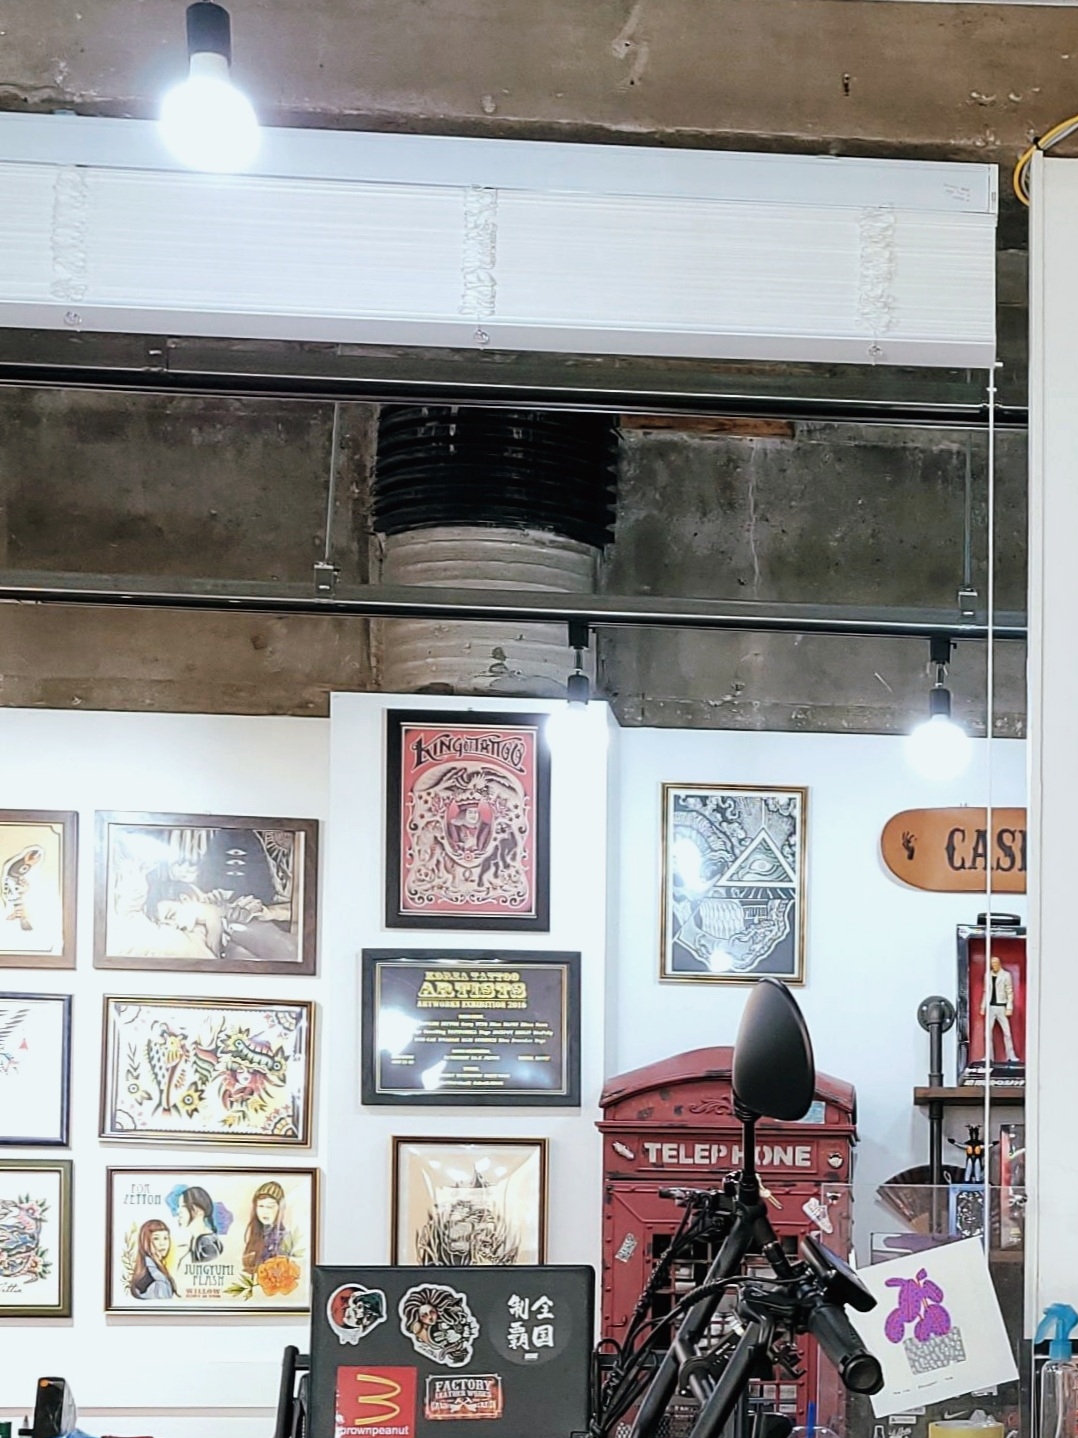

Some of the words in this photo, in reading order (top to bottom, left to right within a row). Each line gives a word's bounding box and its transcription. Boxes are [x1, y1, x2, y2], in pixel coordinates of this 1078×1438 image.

[411, 734, 464, 769] KING
[470, 972, 520, 981] TATTOO
[417, 981, 527, 999] ARTISTS
[643, 1141, 813, 1168] TELEPHONE
[435, 1379, 493, 1392] FACTORY
